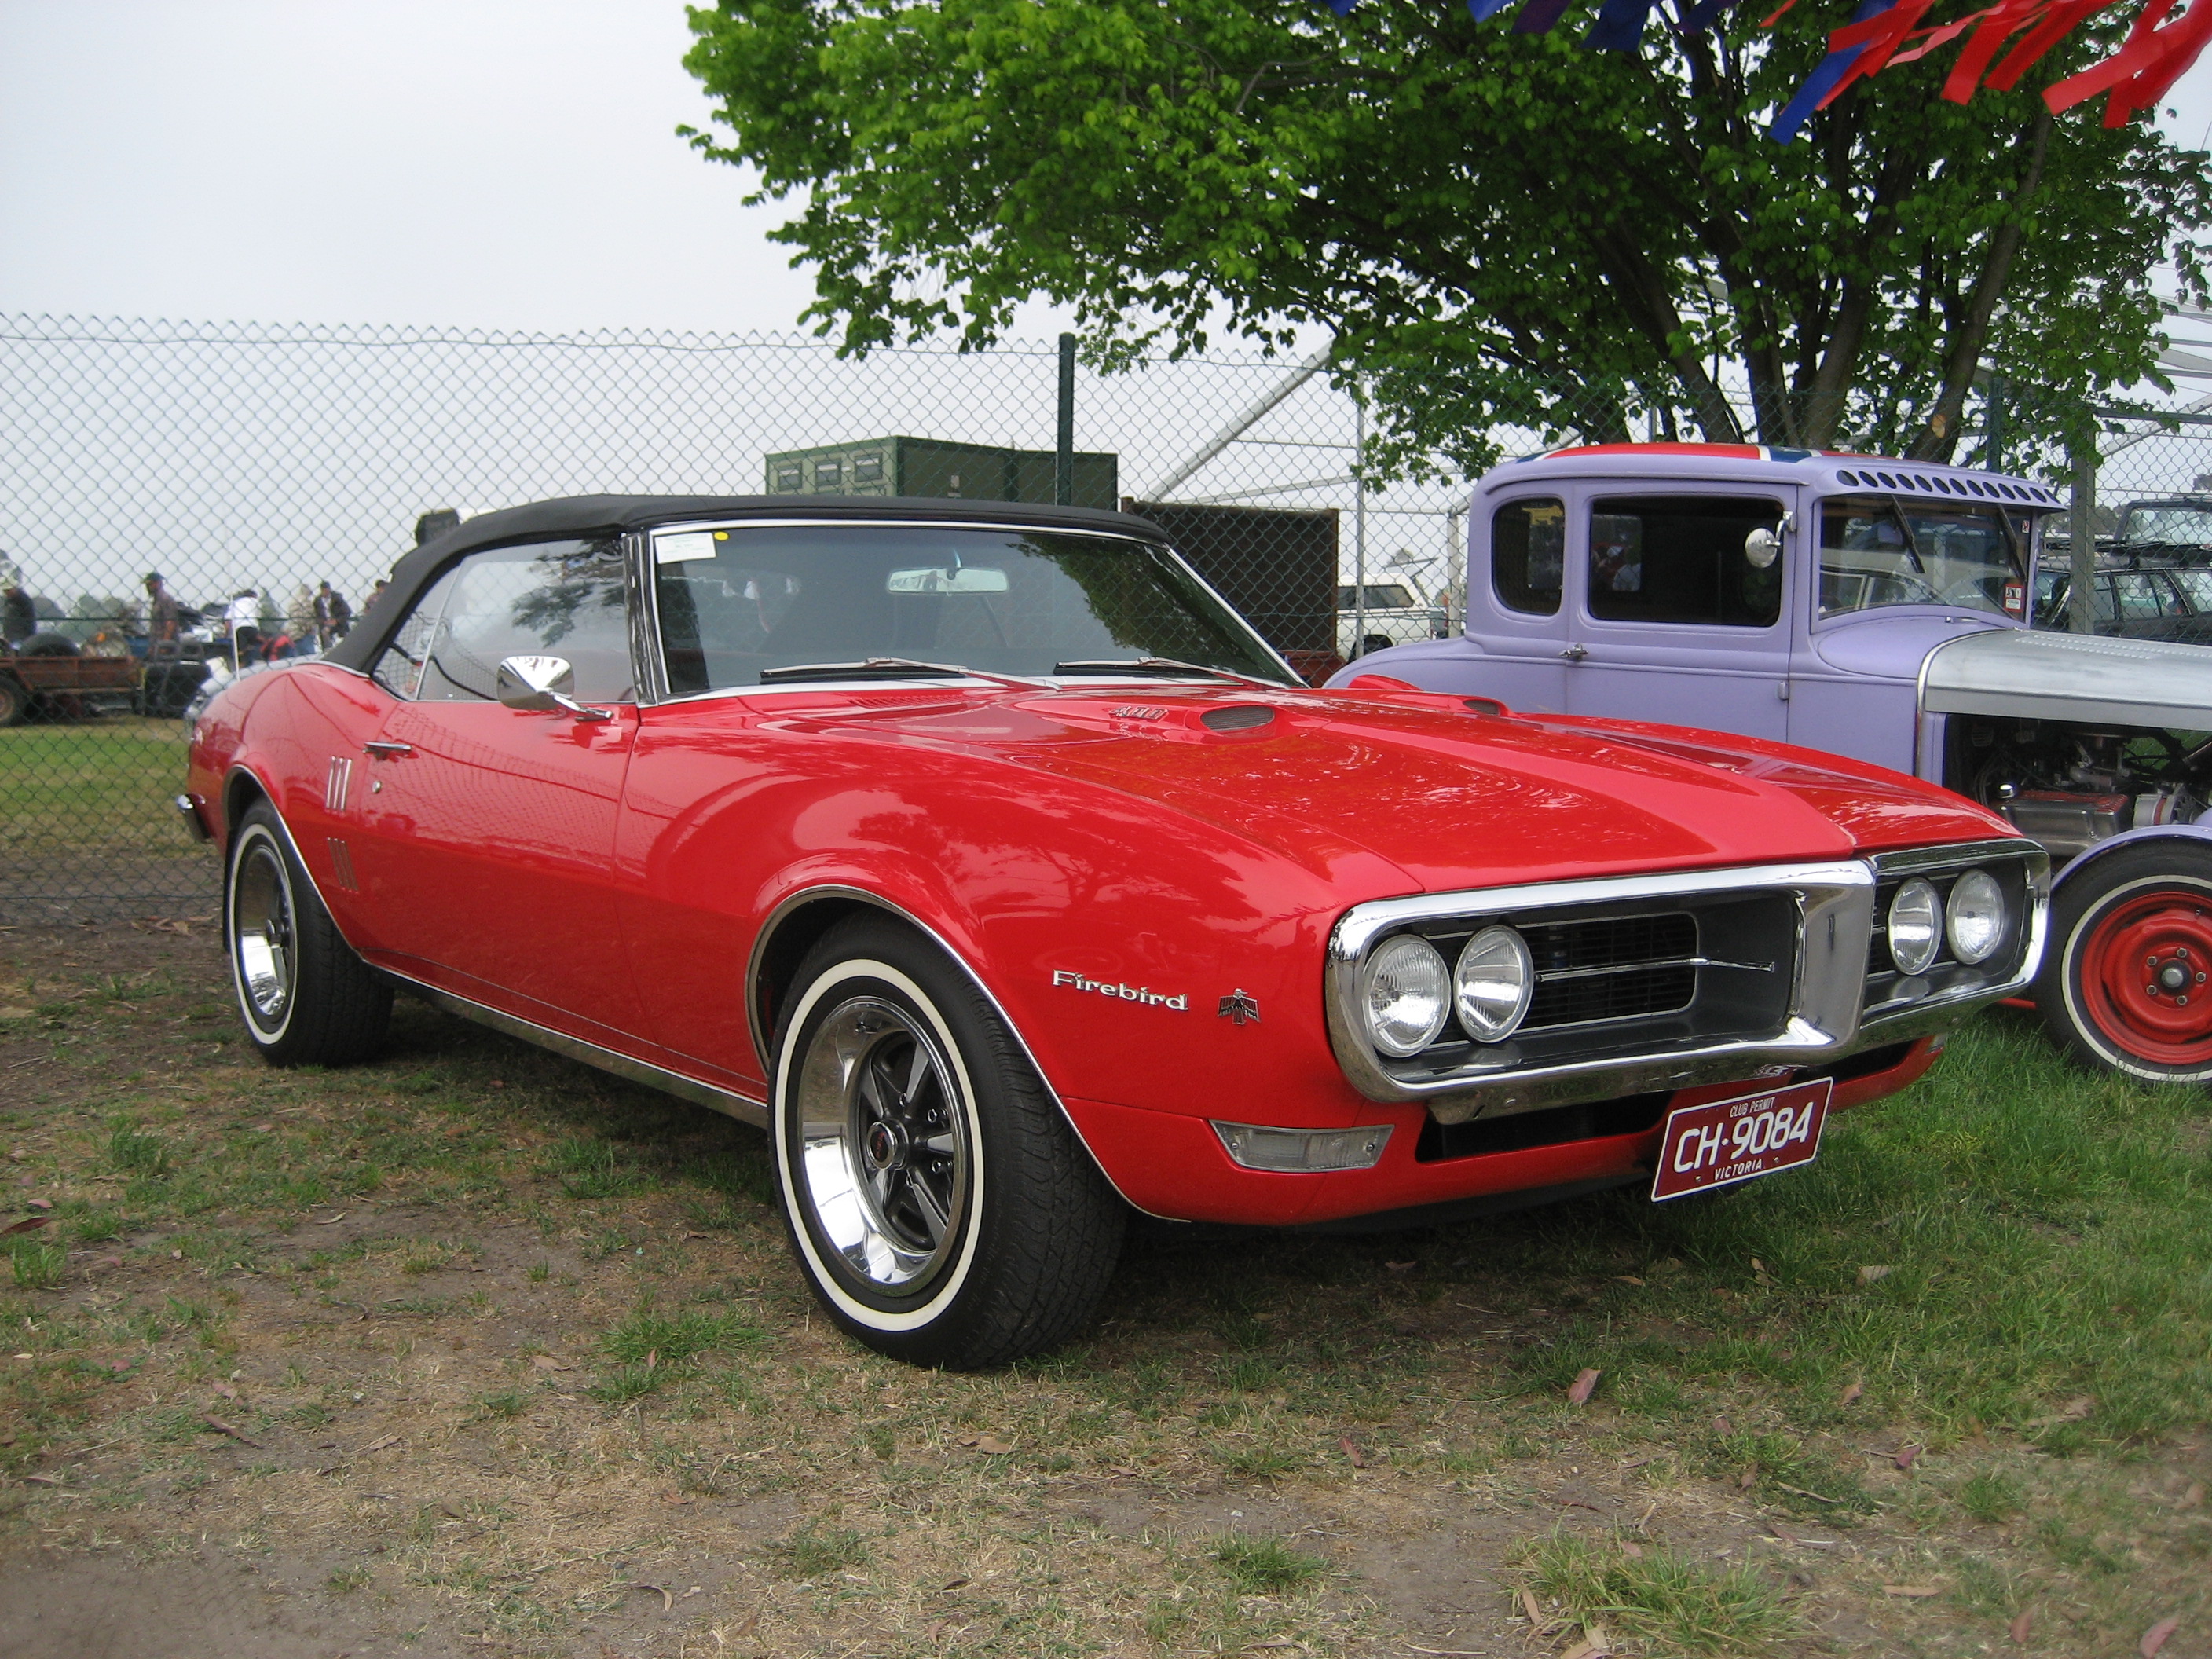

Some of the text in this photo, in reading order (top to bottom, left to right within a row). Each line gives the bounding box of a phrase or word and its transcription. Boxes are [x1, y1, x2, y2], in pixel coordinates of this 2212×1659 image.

[1052, 969, 1189, 1011] Firebird
[1730, 1097, 1776, 1119] CLUB PERMIT
[1714, 1158, 1763, 1181] VICTORIA
